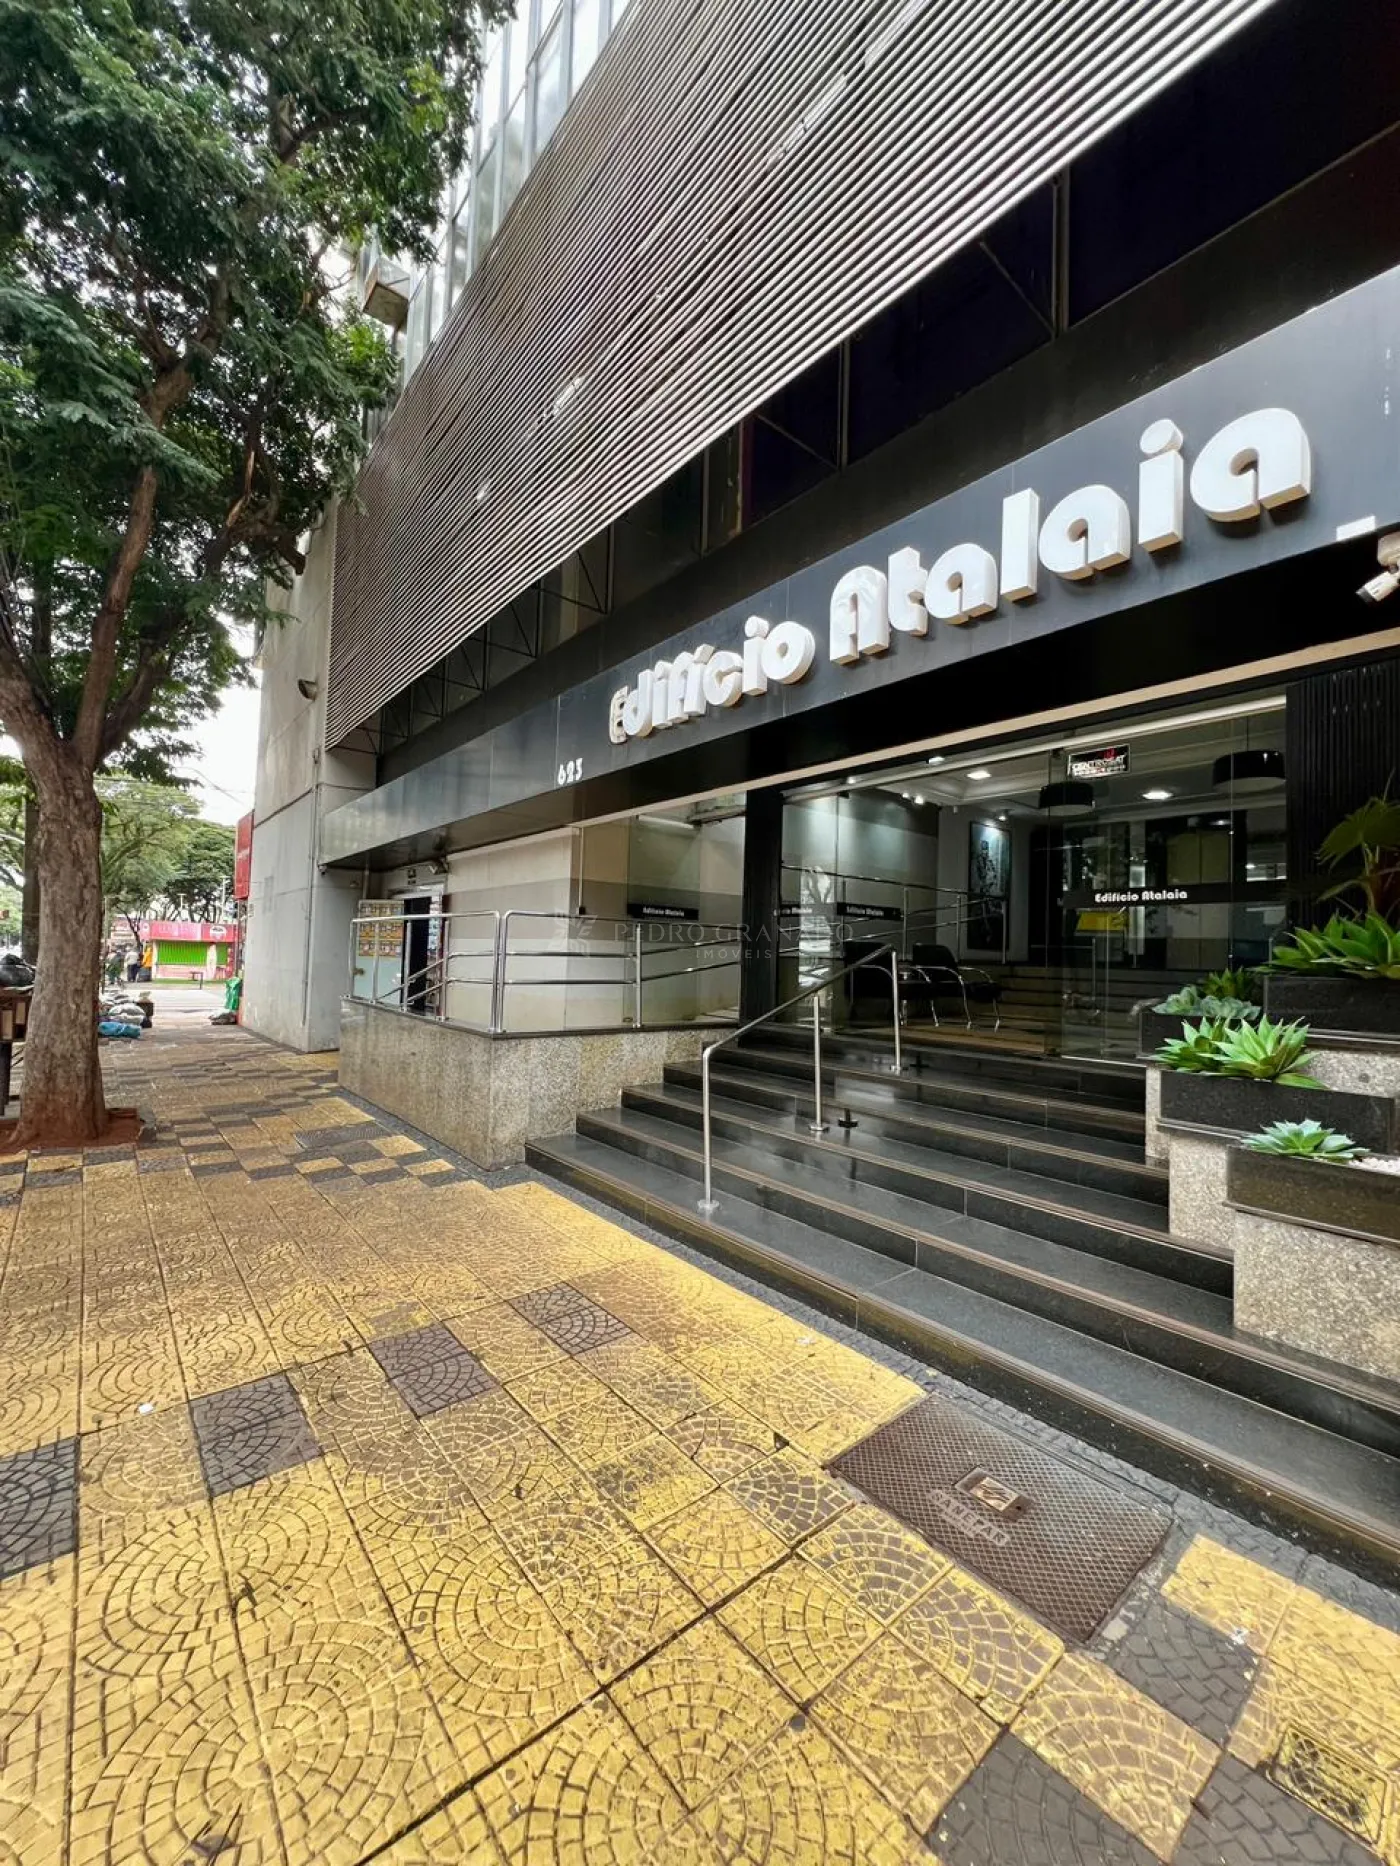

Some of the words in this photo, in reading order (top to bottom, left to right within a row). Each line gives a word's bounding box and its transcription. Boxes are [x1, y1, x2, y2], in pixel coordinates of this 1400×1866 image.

[829, 407, 1311, 665] Atalaia
[557, 757, 583, 785] 623
[1141, 888, 1188, 901] Atalaia
